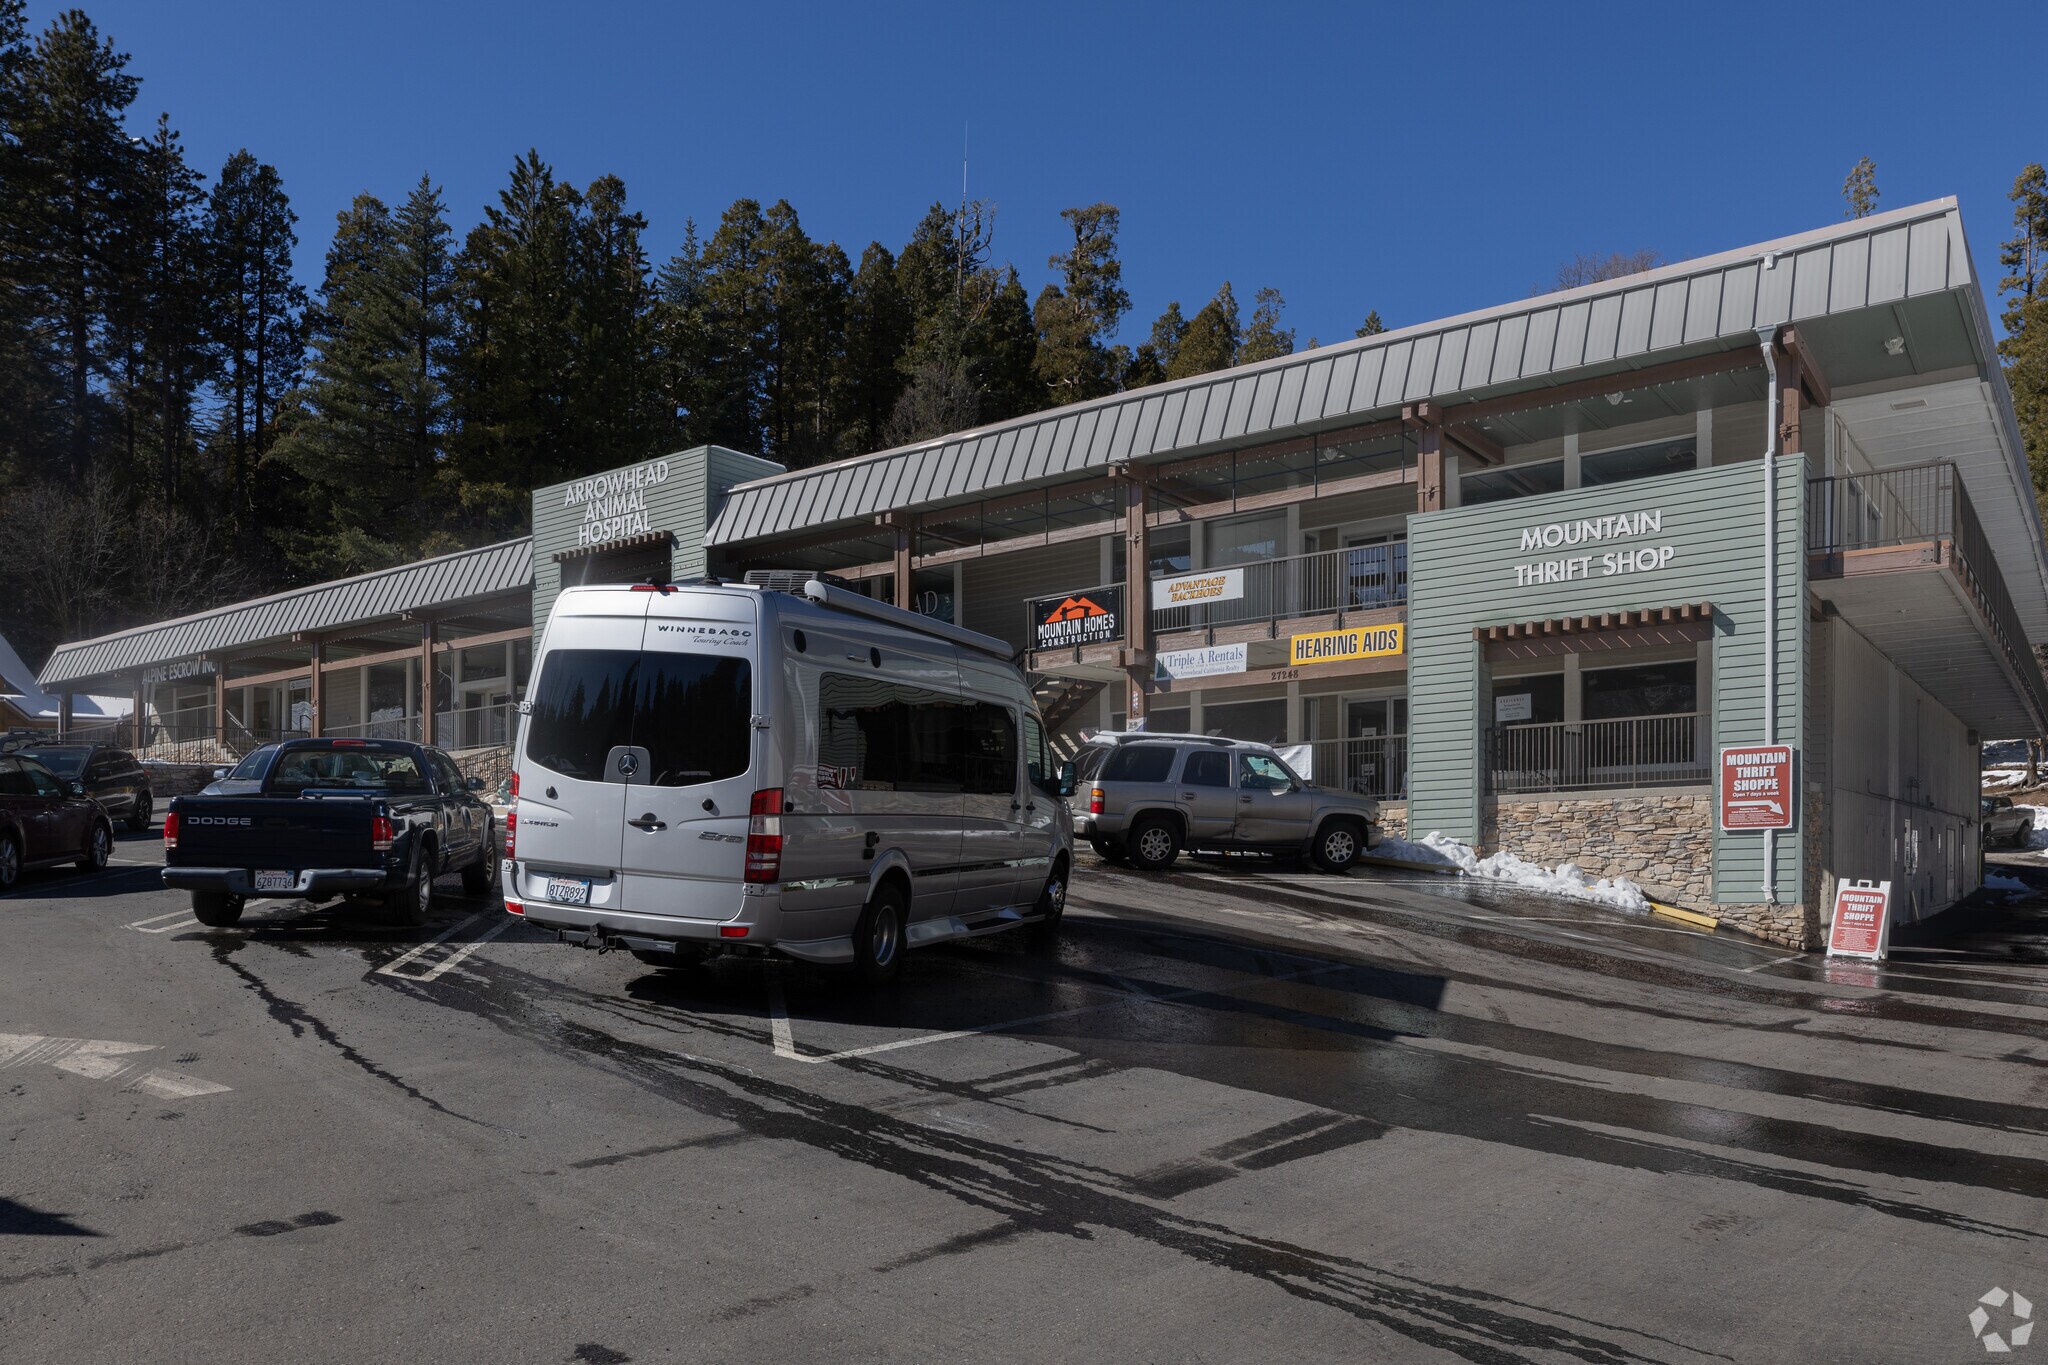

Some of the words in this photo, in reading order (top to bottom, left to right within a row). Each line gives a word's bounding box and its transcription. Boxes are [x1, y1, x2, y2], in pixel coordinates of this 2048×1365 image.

[565, 461, 669, 506] ARROWHEAD
[584, 489, 647, 523] ANIMAL
[579, 510, 652, 545] HOSPITAL
[1520, 510, 1662, 551] MOUNTAIN
[1514, 556, 1593, 586] THRIFT
[1602, 546, 1675, 576] SHOP
[1168, 576, 1226, 593] ADVANTAGE
[1171, 586, 1223, 602] BACKHOES
[658, 625, 752, 637] WINNEBAGO
[1038, 619, 1081, 640] MOUNTAIN
[1085, 613, 1114, 632] HOMES
[693, 636, 721, 646] Touring
[724, 638, 748, 646] Coach
[1041, 630, 1110, 648] CONSTRUCTION
[1296, 633, 1358, 659] HEARING
[1363, 629, 1398, 652] AIDS
[1167, 653, 1195, 669] Triple
[1198, 651, 1204, 664] A
[1208, 647, 1243, 663] Rentals
[142, 666, 167, 684] ALPINE
[169, 659, 201, 680] ESCROW
[1271, 669, 1299, 680] 27248
[1726, 752, 1786, 766] MOUNTAIN
[1736, 766, 1776, 778] THRIFT
[1733, 779, 1779, 791] SHOPPE
[188, 817, 251, 825] DODGE
[256, 877, 292, 888] 6Z87736
[549, 883, 585, 899] 8TZR892
[1841, 894, 1883, 904] MOUNTAIN
[1847, 903, 1875, 913] THRIFT
[1843, 912, 1875, 922] SHOPPE
